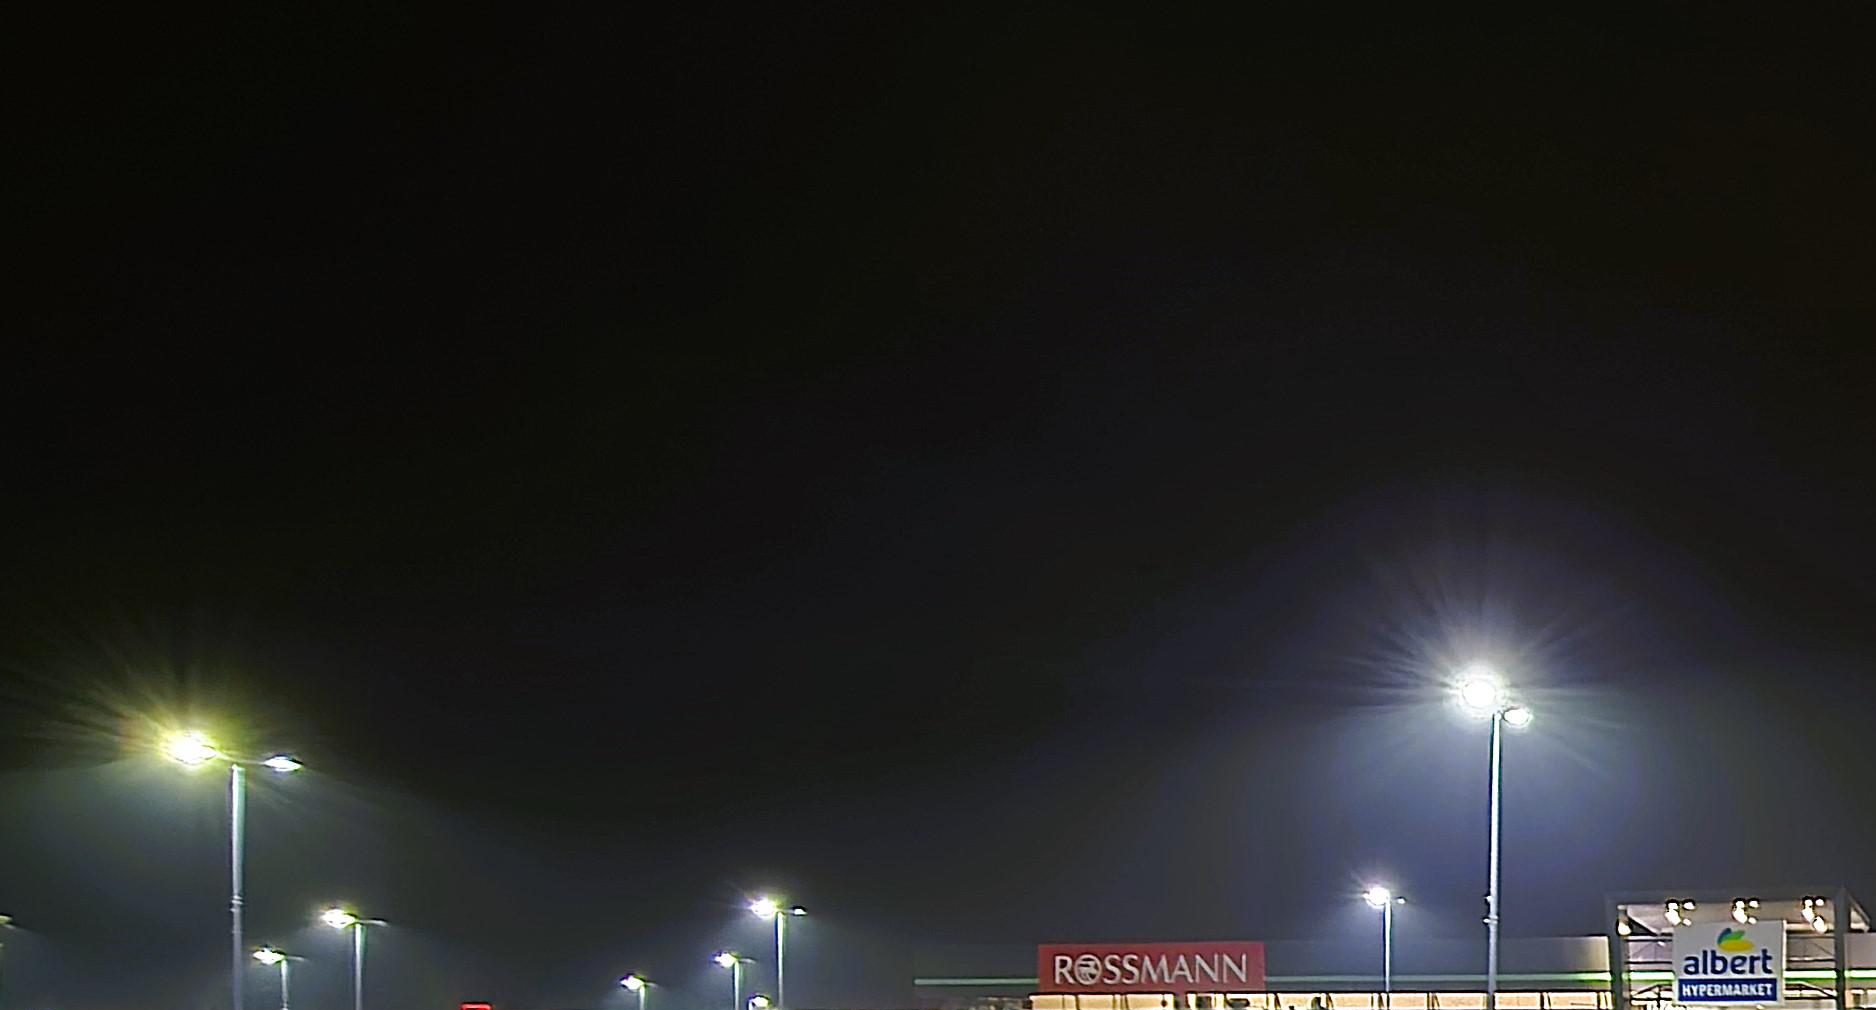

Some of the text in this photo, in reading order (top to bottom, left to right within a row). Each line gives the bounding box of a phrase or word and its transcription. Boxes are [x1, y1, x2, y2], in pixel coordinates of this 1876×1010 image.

[1054, 953, 1248, 986] ROSSMANN
[1683, 948, 1774, 976] albert
[1682, 983, 1773, 997] HYPERMARKET
